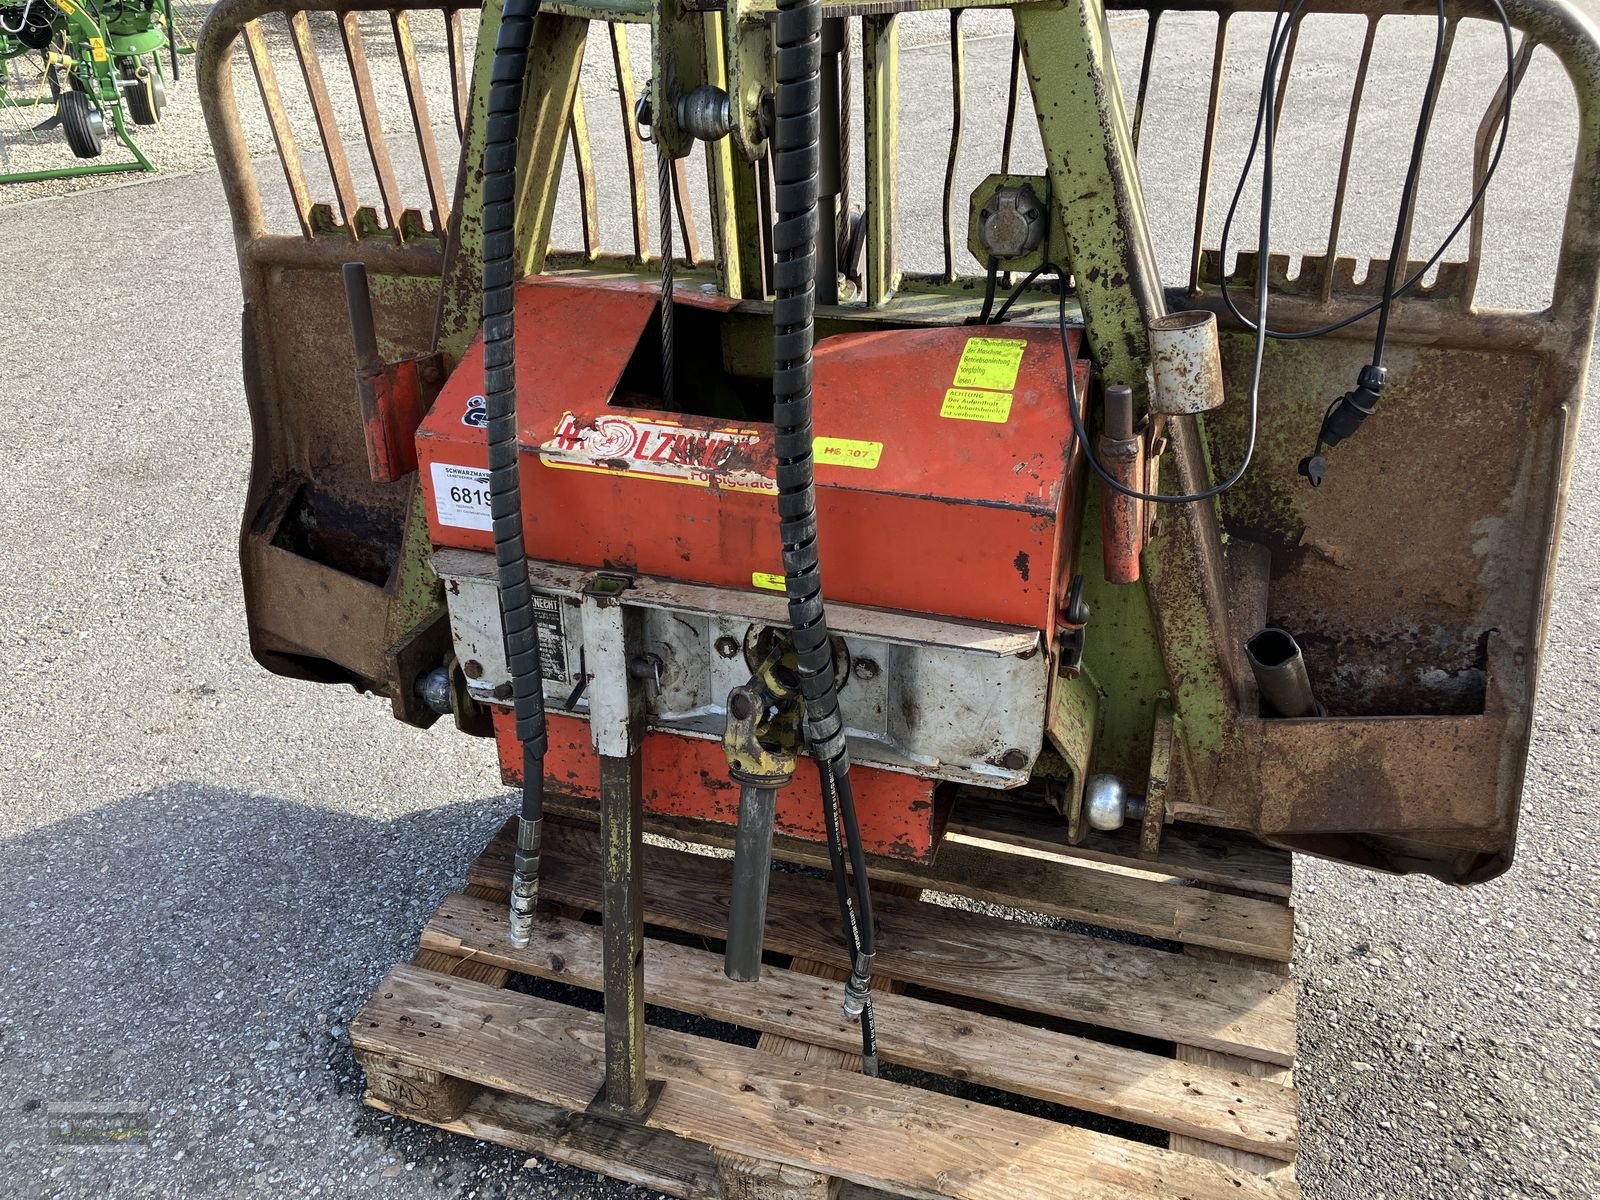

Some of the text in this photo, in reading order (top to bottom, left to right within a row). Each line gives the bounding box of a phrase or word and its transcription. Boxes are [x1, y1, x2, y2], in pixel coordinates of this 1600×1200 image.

[949, 390, 984, 399] ACHTUNG
[961, 398, 999, 406] Aufenthalt
[847, 448, 869, 458] 307
